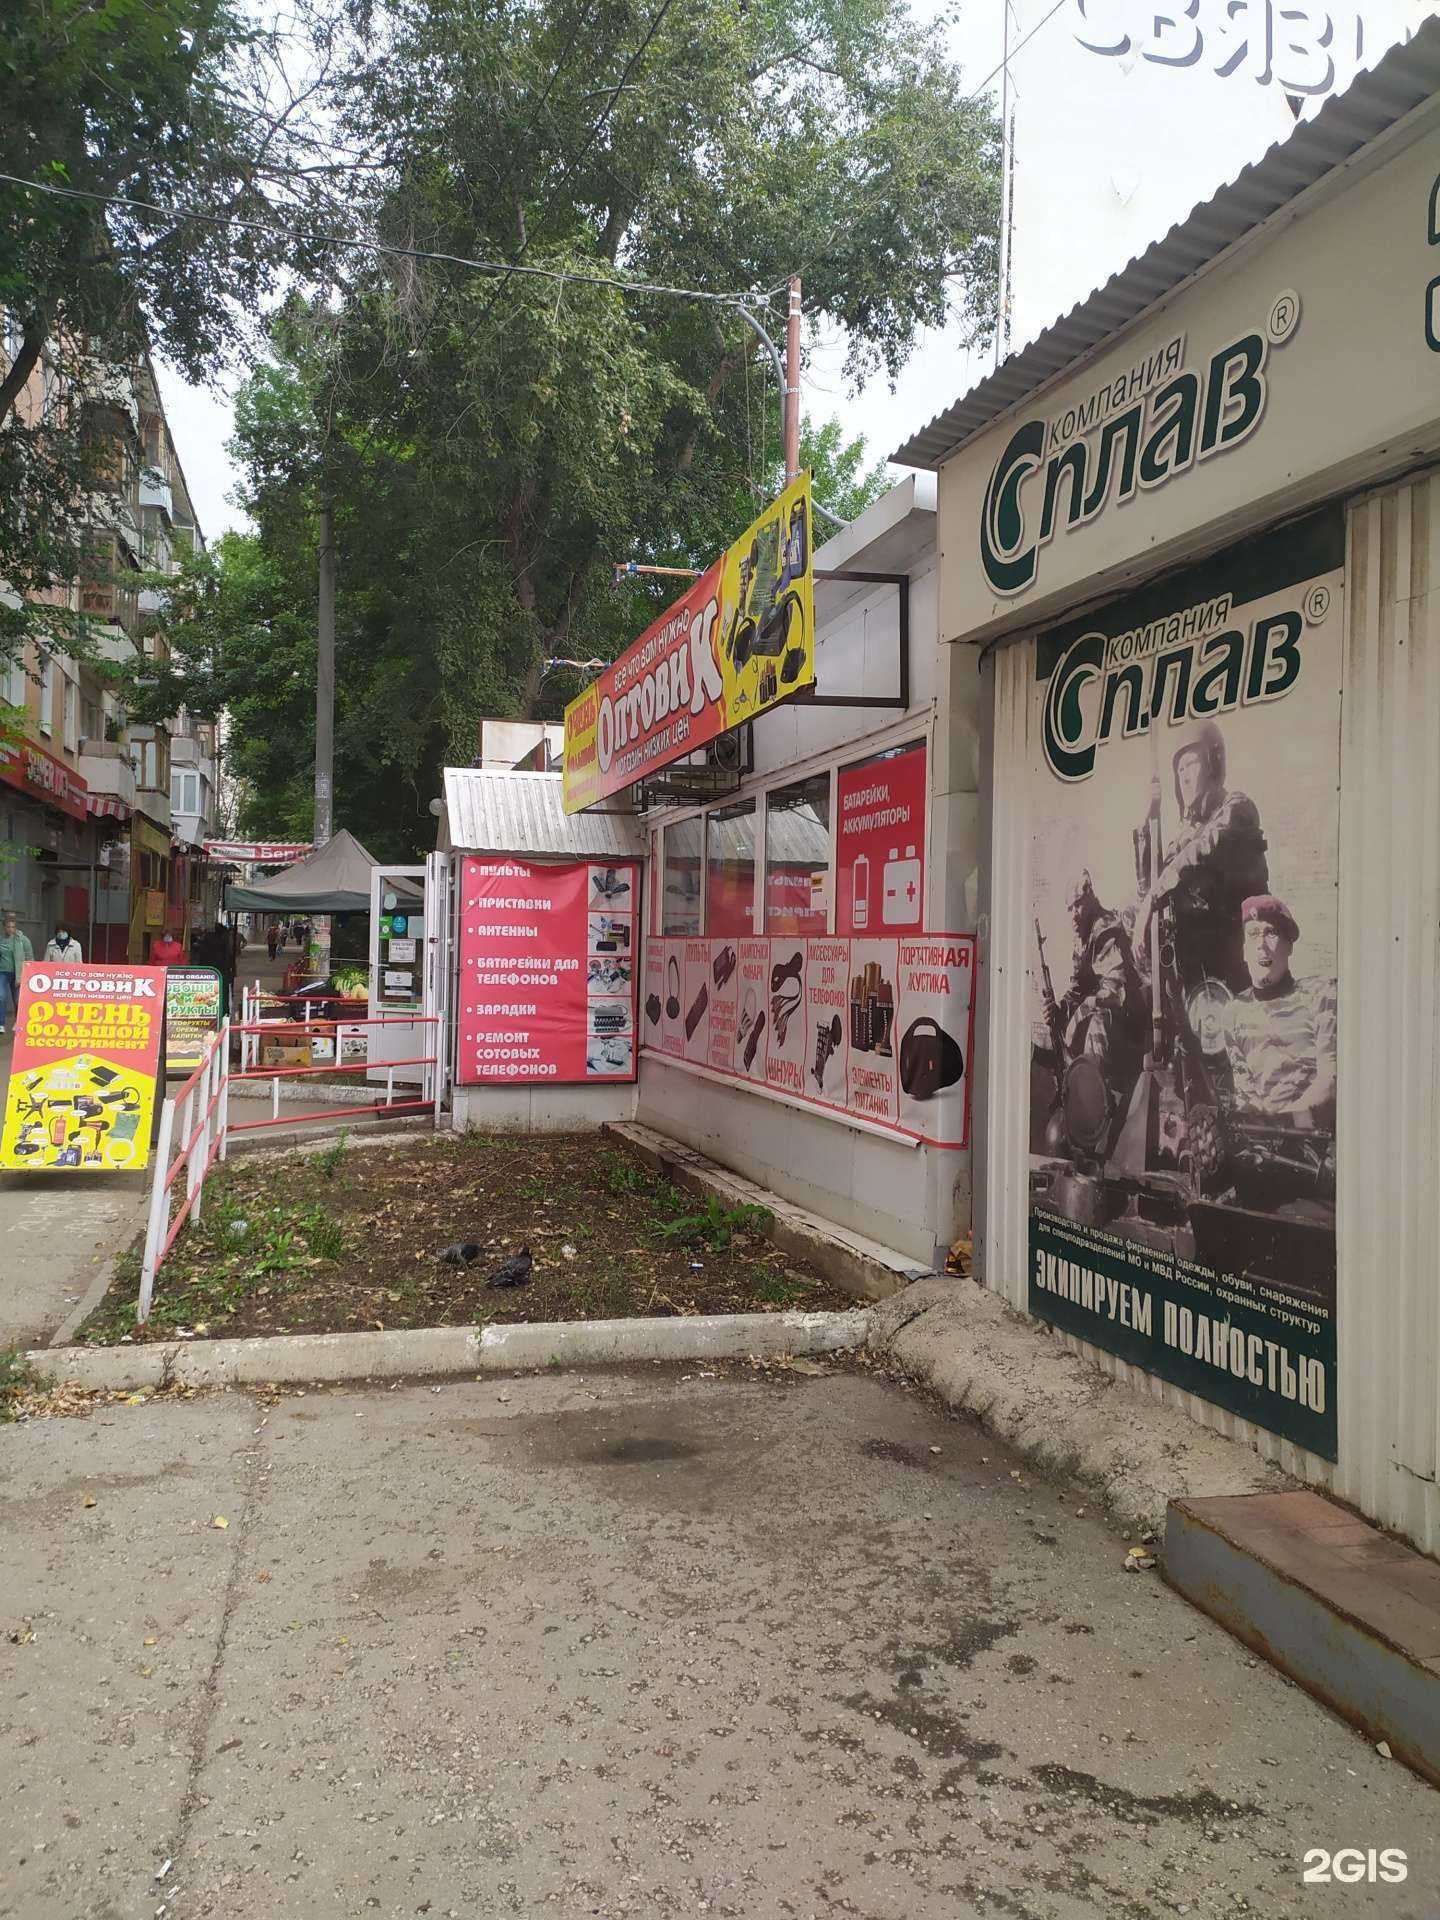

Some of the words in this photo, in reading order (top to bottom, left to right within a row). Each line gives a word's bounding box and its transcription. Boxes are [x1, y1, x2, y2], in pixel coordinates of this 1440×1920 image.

[1049, 334, 1182, 446] компания
[1108, 600, 1230, 667] компания
[843, 783, 891, 811] БАТАРЕЙКИ,
[843, 804, 910, 835] АККУМУЛЯТОРЫ
[478, 898, 552, 911] ПРИСТАВКИ
[478, 924, 538, 937] АНТЕННЫ
[477, 956, 551, 970] БАТАРЕЙКИ
[554, 959, 579, 972] ДЛЯ
[809, 944, 849, 962] АКСЕССУАРЫ
[900, 945, 969, 968] ПОРТАТИВНАЯ
[476, 973, 558, 986] ТЕЛЕФОНОВ
[908, 971, 950, 994] АКУСТИКА
[476, 1004, 537, 1017] ЗАРЯДКИ
[476, 1032, 530, 1044] РЕМОНТ
[476, 1048, 541, 1060] СОТОВЫХ
[476, 1064, 557, 1076] ТЕЛЕФОНОВ
[768, 1056, 805, 1092] ШНУРЫ
[1034, 1205, 1082, 1232] Производство
[1090, 1227, 1123, 1247] продажа
[1126, 1238, 1175, 1265] фирменной
[1177, 1258, 1219, 1282] одежды,
[1222, 1273, 1256, 1296] обуви,
[1259, 1286, 1329, 1320] снаряжения
[1128, 1252, 1142, 1268] МО
[1152, 1261, 1173, 1281] МВД
[1175, 1269, 1213, 1296] России,
[1216, 1286, 1267, 1314] охранных
[1269, 1306, 1321, 1336] структур
[1035, 1248, 1153, 1337] ЭКИПИРУЕМ
[1164, 1299, 1326, 1415] ПОЛНОСТЬЮ
